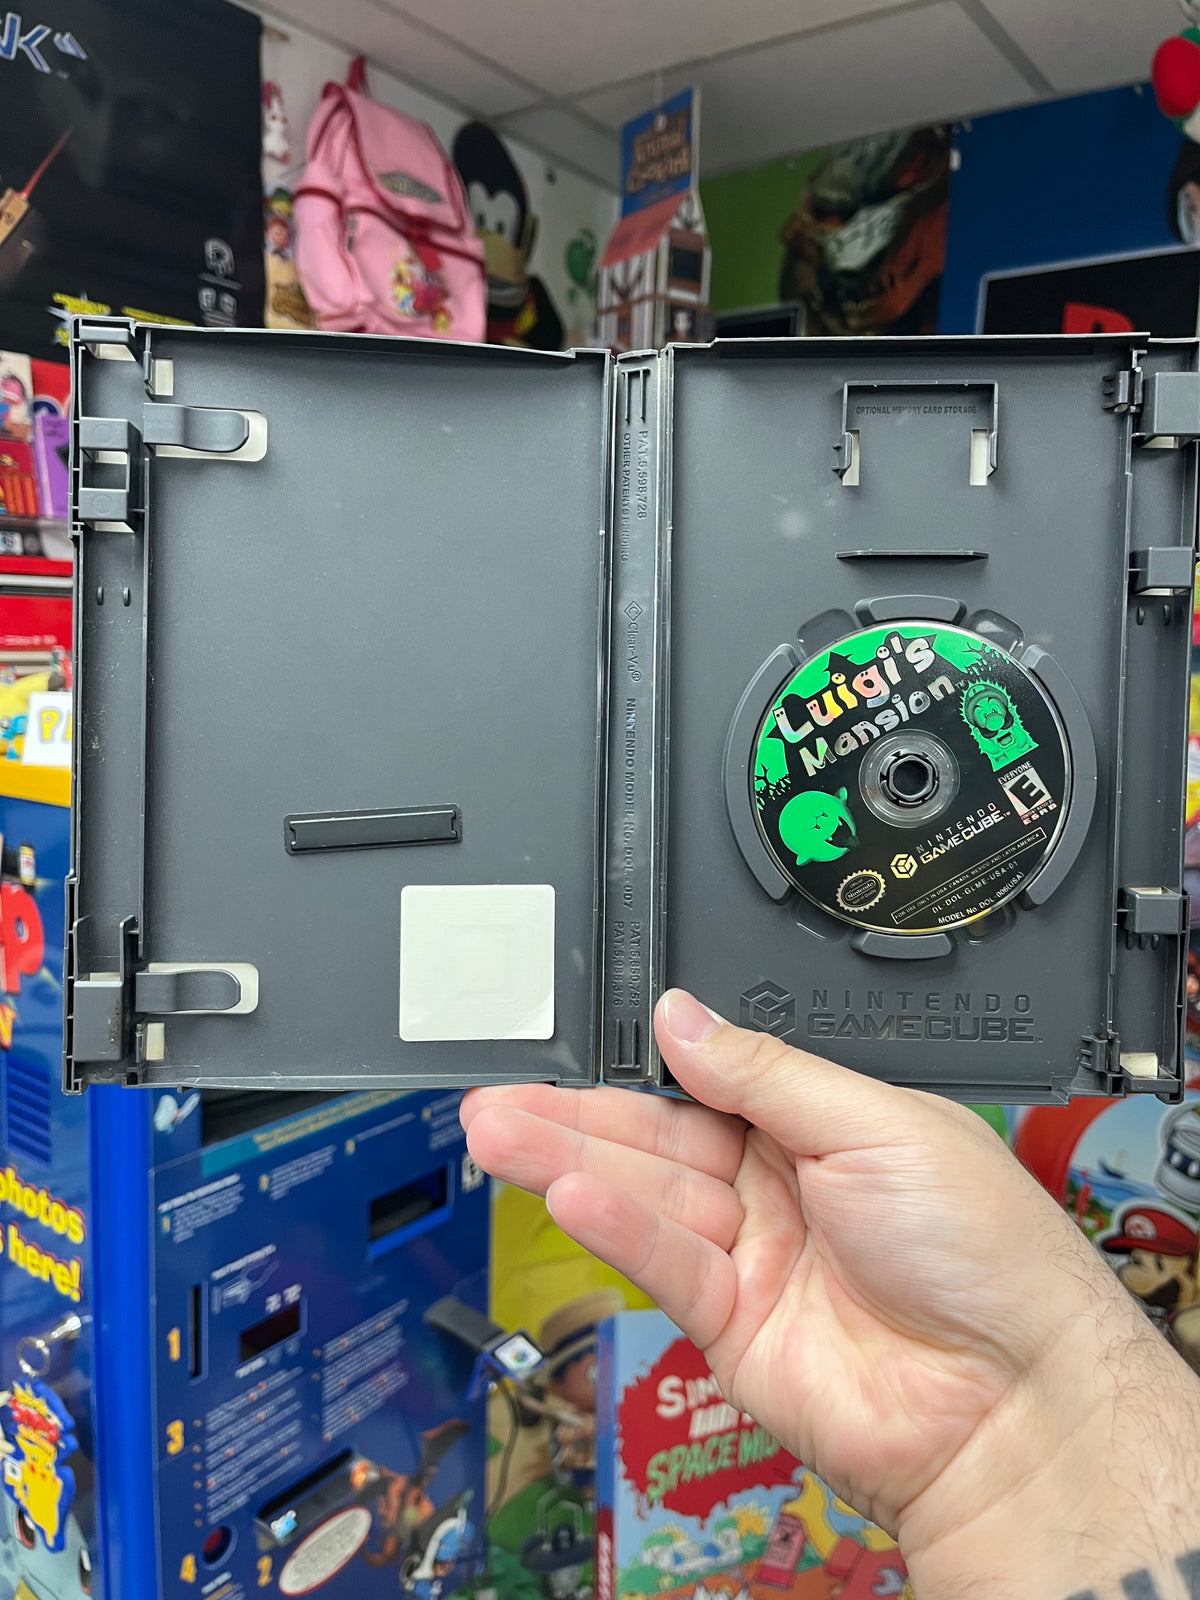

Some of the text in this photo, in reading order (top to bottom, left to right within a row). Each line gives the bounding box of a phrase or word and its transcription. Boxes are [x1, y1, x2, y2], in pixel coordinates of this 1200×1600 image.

[856, 405, 977, 415] OPTIONAL MEMORY CARD STORAGE
[622, 433, 631, 468] OTHER
[621, 469, 631, 516] PATENTS
[773, 636, 936, 743] Luigi's
[625, 698, 637, 768] NINTENDO
[997, 760, 1033, 785] EVERYONE
[624, 771, 636, 819] MODEL
[1008, 774, 1046, 809] E
[916, 802, 997, 853] NINTENDO
[1022, 803, 1057, 825] ESRB
[1017, 833, 1040, 848] AMERICA
[847, 881, 874, 899] Nintendo
[938, 910, 966, 925] MODEL
[811, 989, 1032, 1015] NINTENDO
[8, 1222, 83, 1302] here!
[646, 1432, 739, 1501] SPACE
